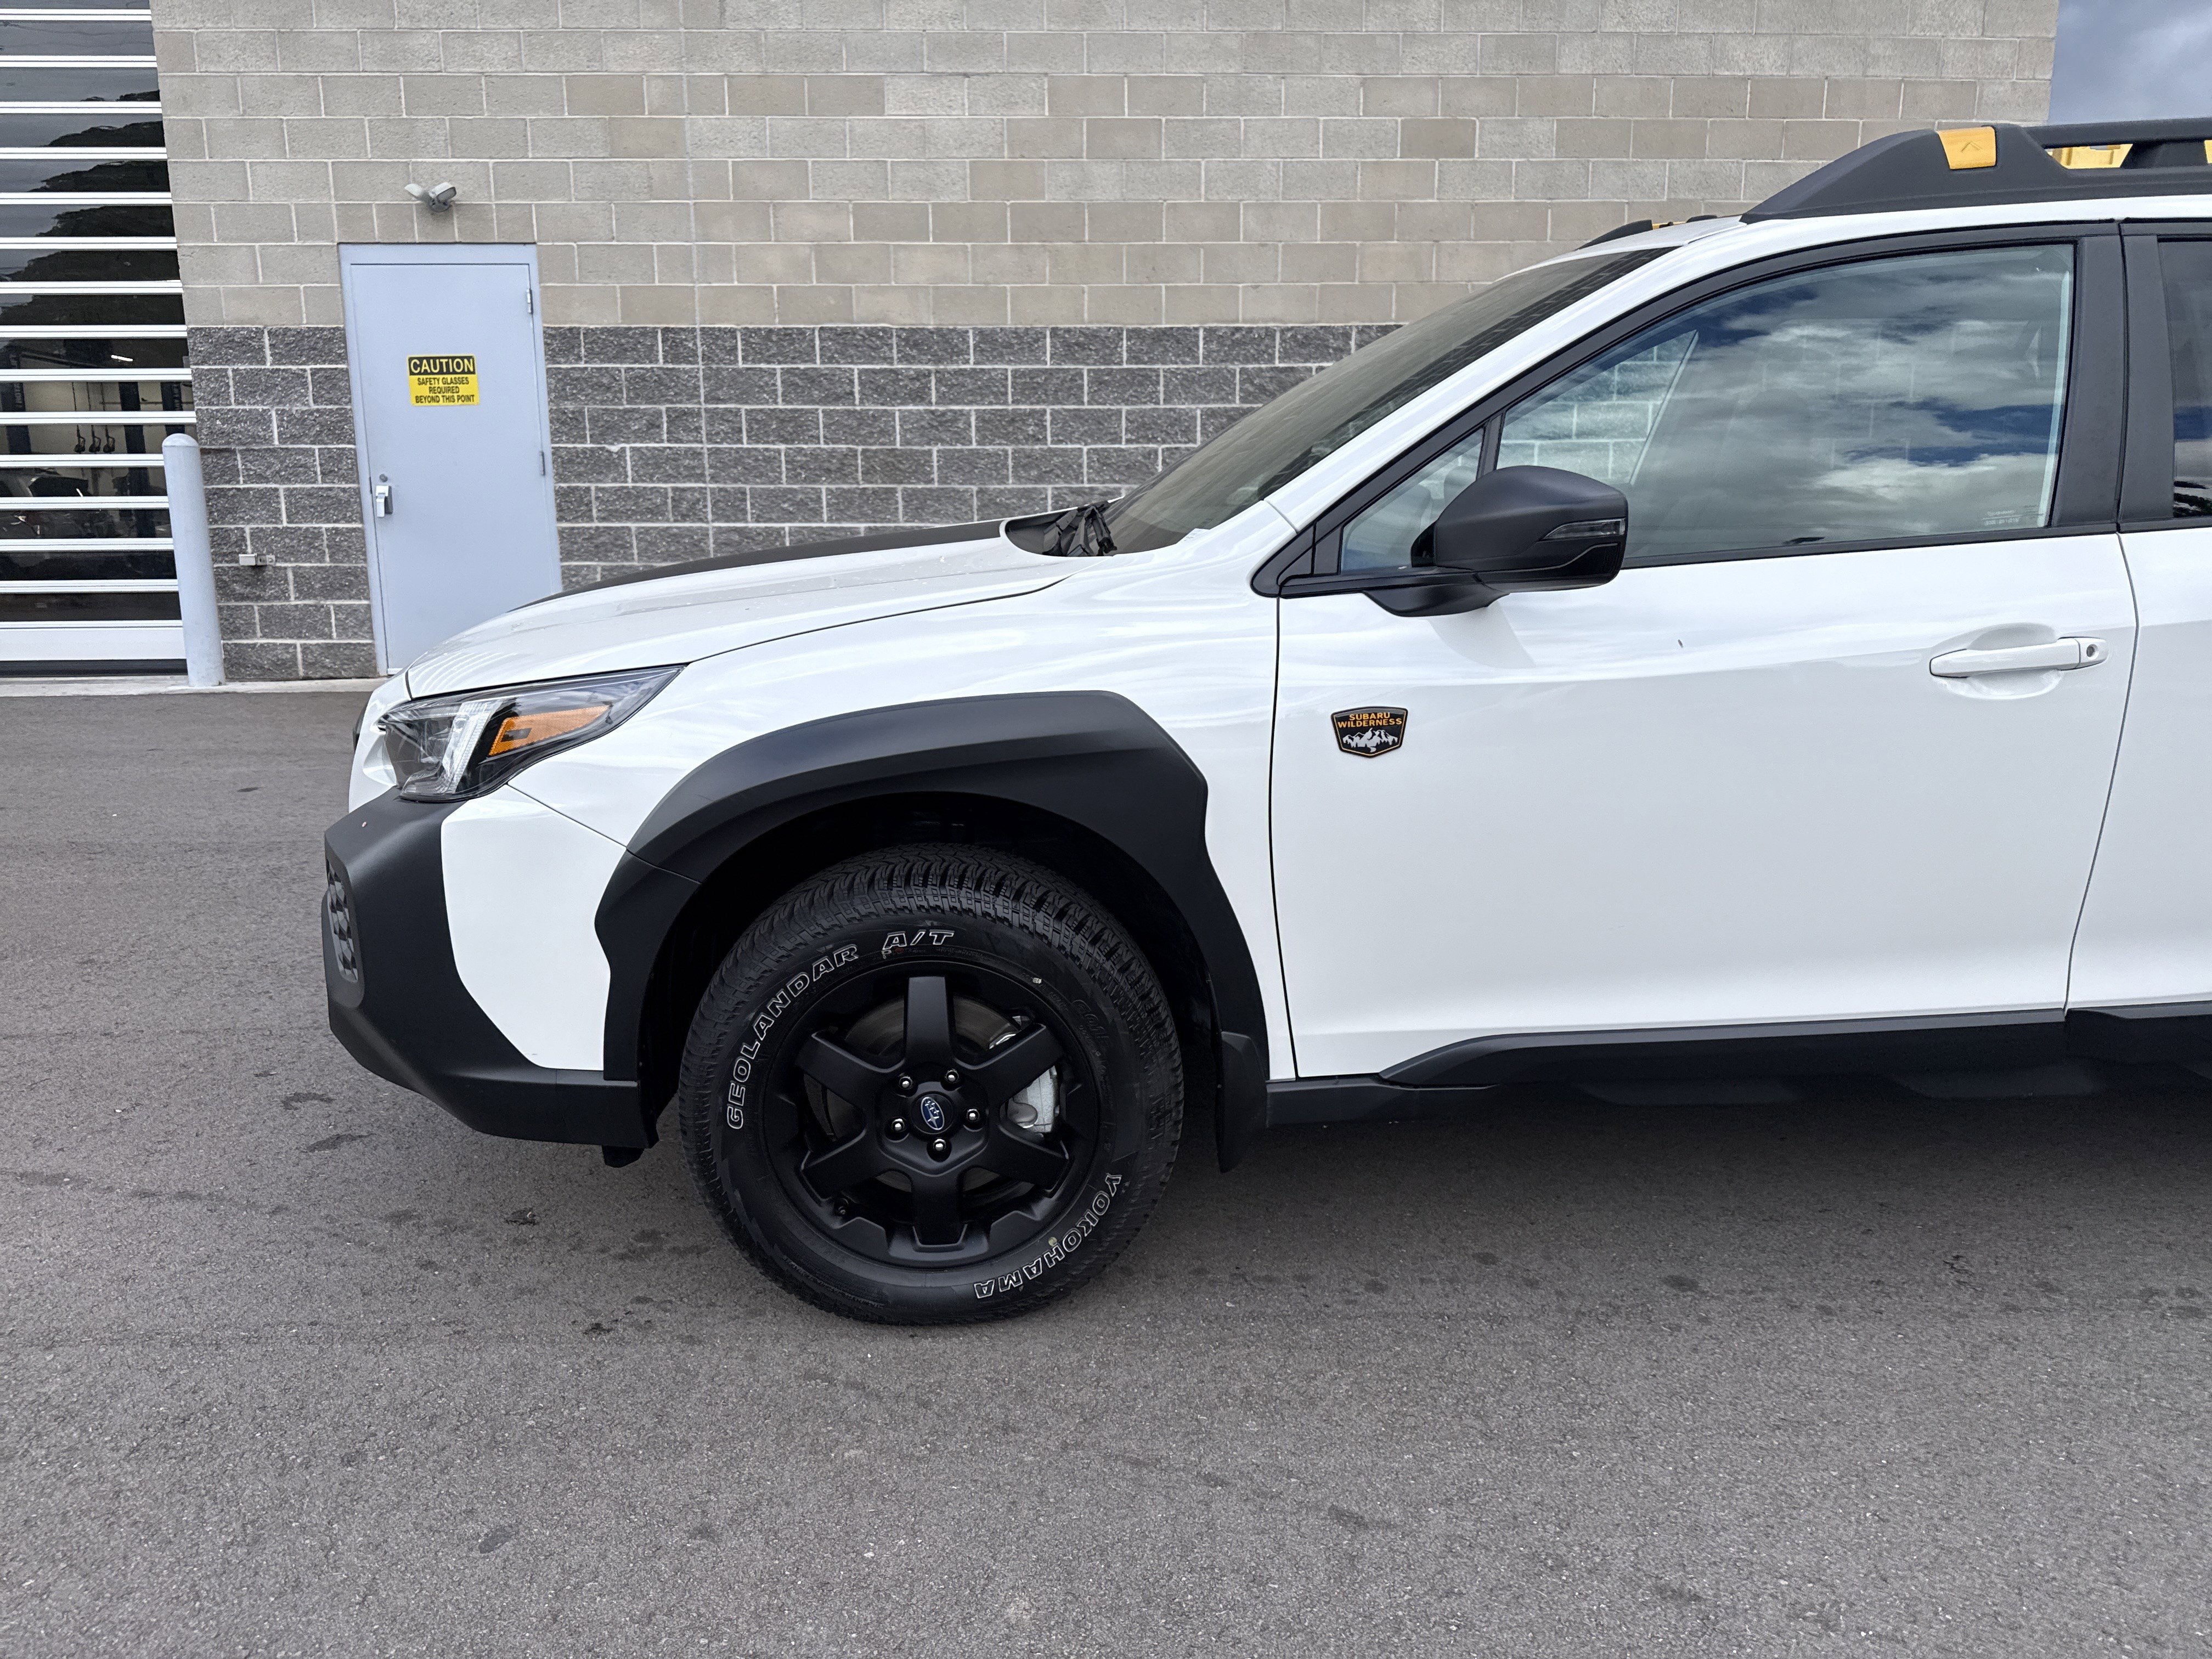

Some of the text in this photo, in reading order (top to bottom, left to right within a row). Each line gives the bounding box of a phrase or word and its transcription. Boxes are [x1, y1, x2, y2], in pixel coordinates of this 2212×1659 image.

[410, 359, 473, 373] CAUTION
[457, 394, 475, 403] POINT
[1349, 712, 1390, 720] SUBARU
[1338, 718, 1402, 728] WILDERNESS
[726, 930, 955, 1130] GEOLANDAR A/T
[974, 1172, 1122, 1300] YOKOHAMA
